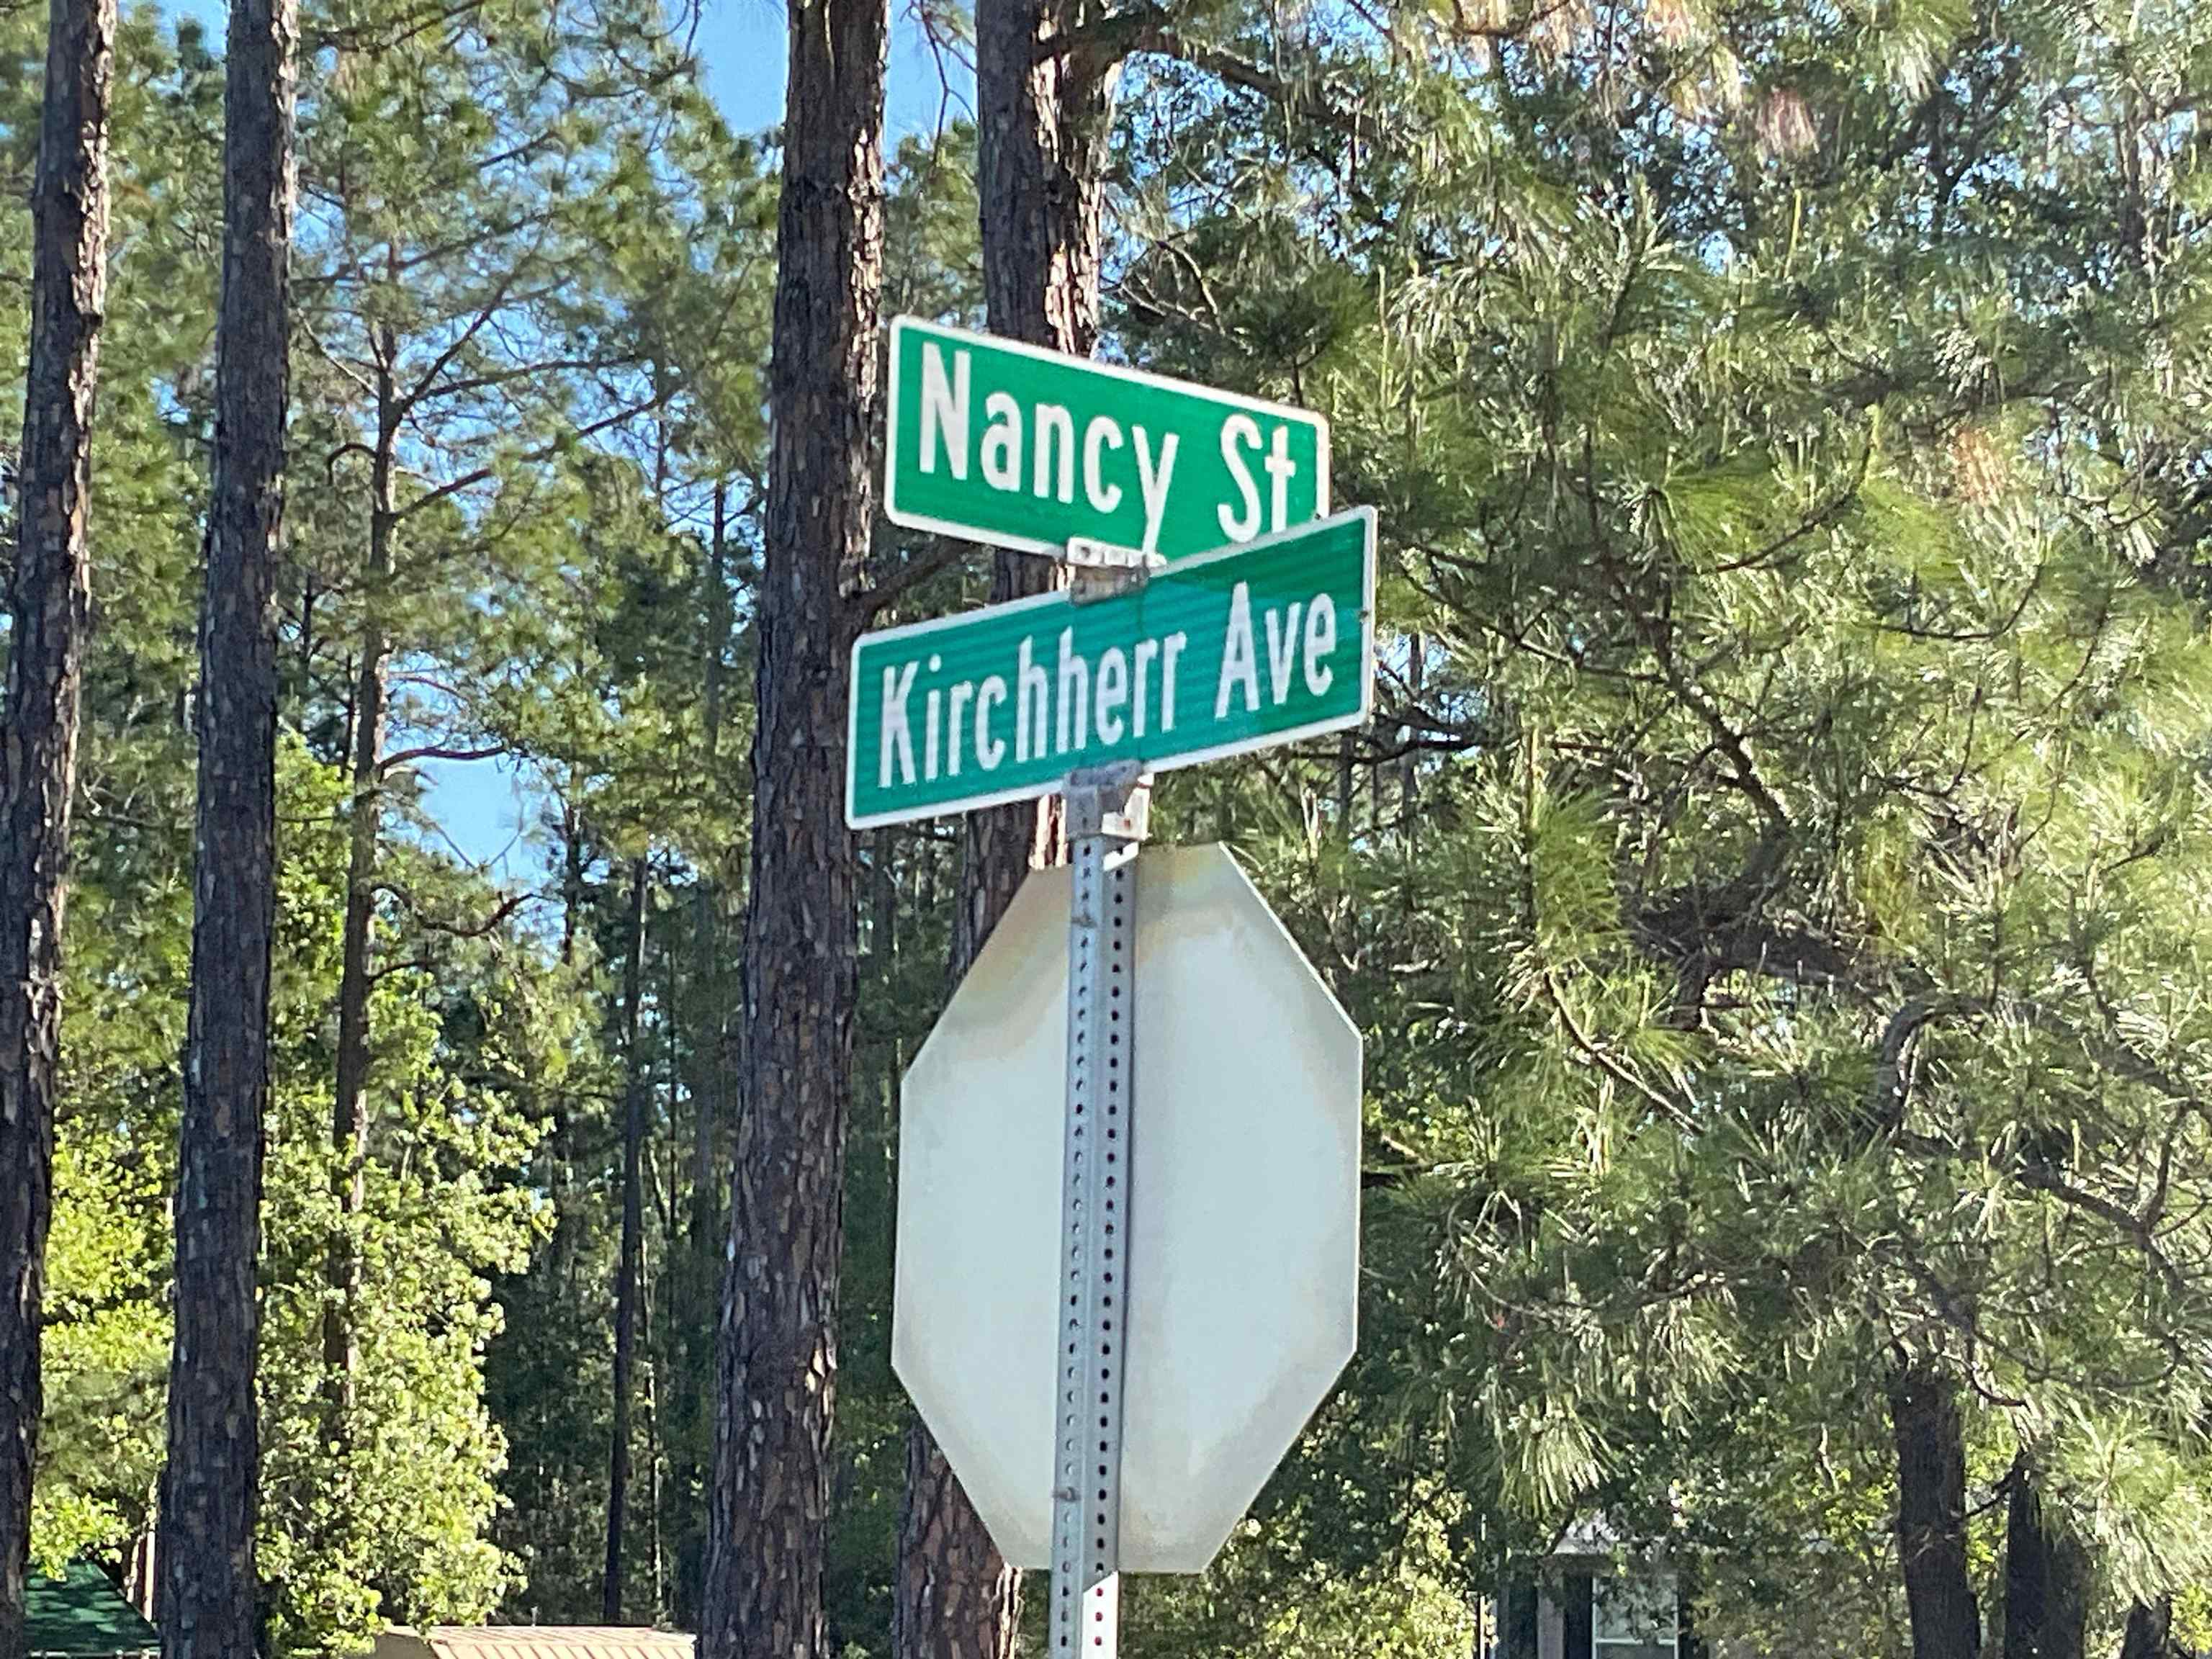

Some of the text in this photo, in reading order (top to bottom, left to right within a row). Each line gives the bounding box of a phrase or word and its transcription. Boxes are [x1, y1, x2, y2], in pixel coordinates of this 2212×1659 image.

[919, 341, 1296, 557] Nancy St
[878, 581, 1337, 788] Kirchherr Ave
